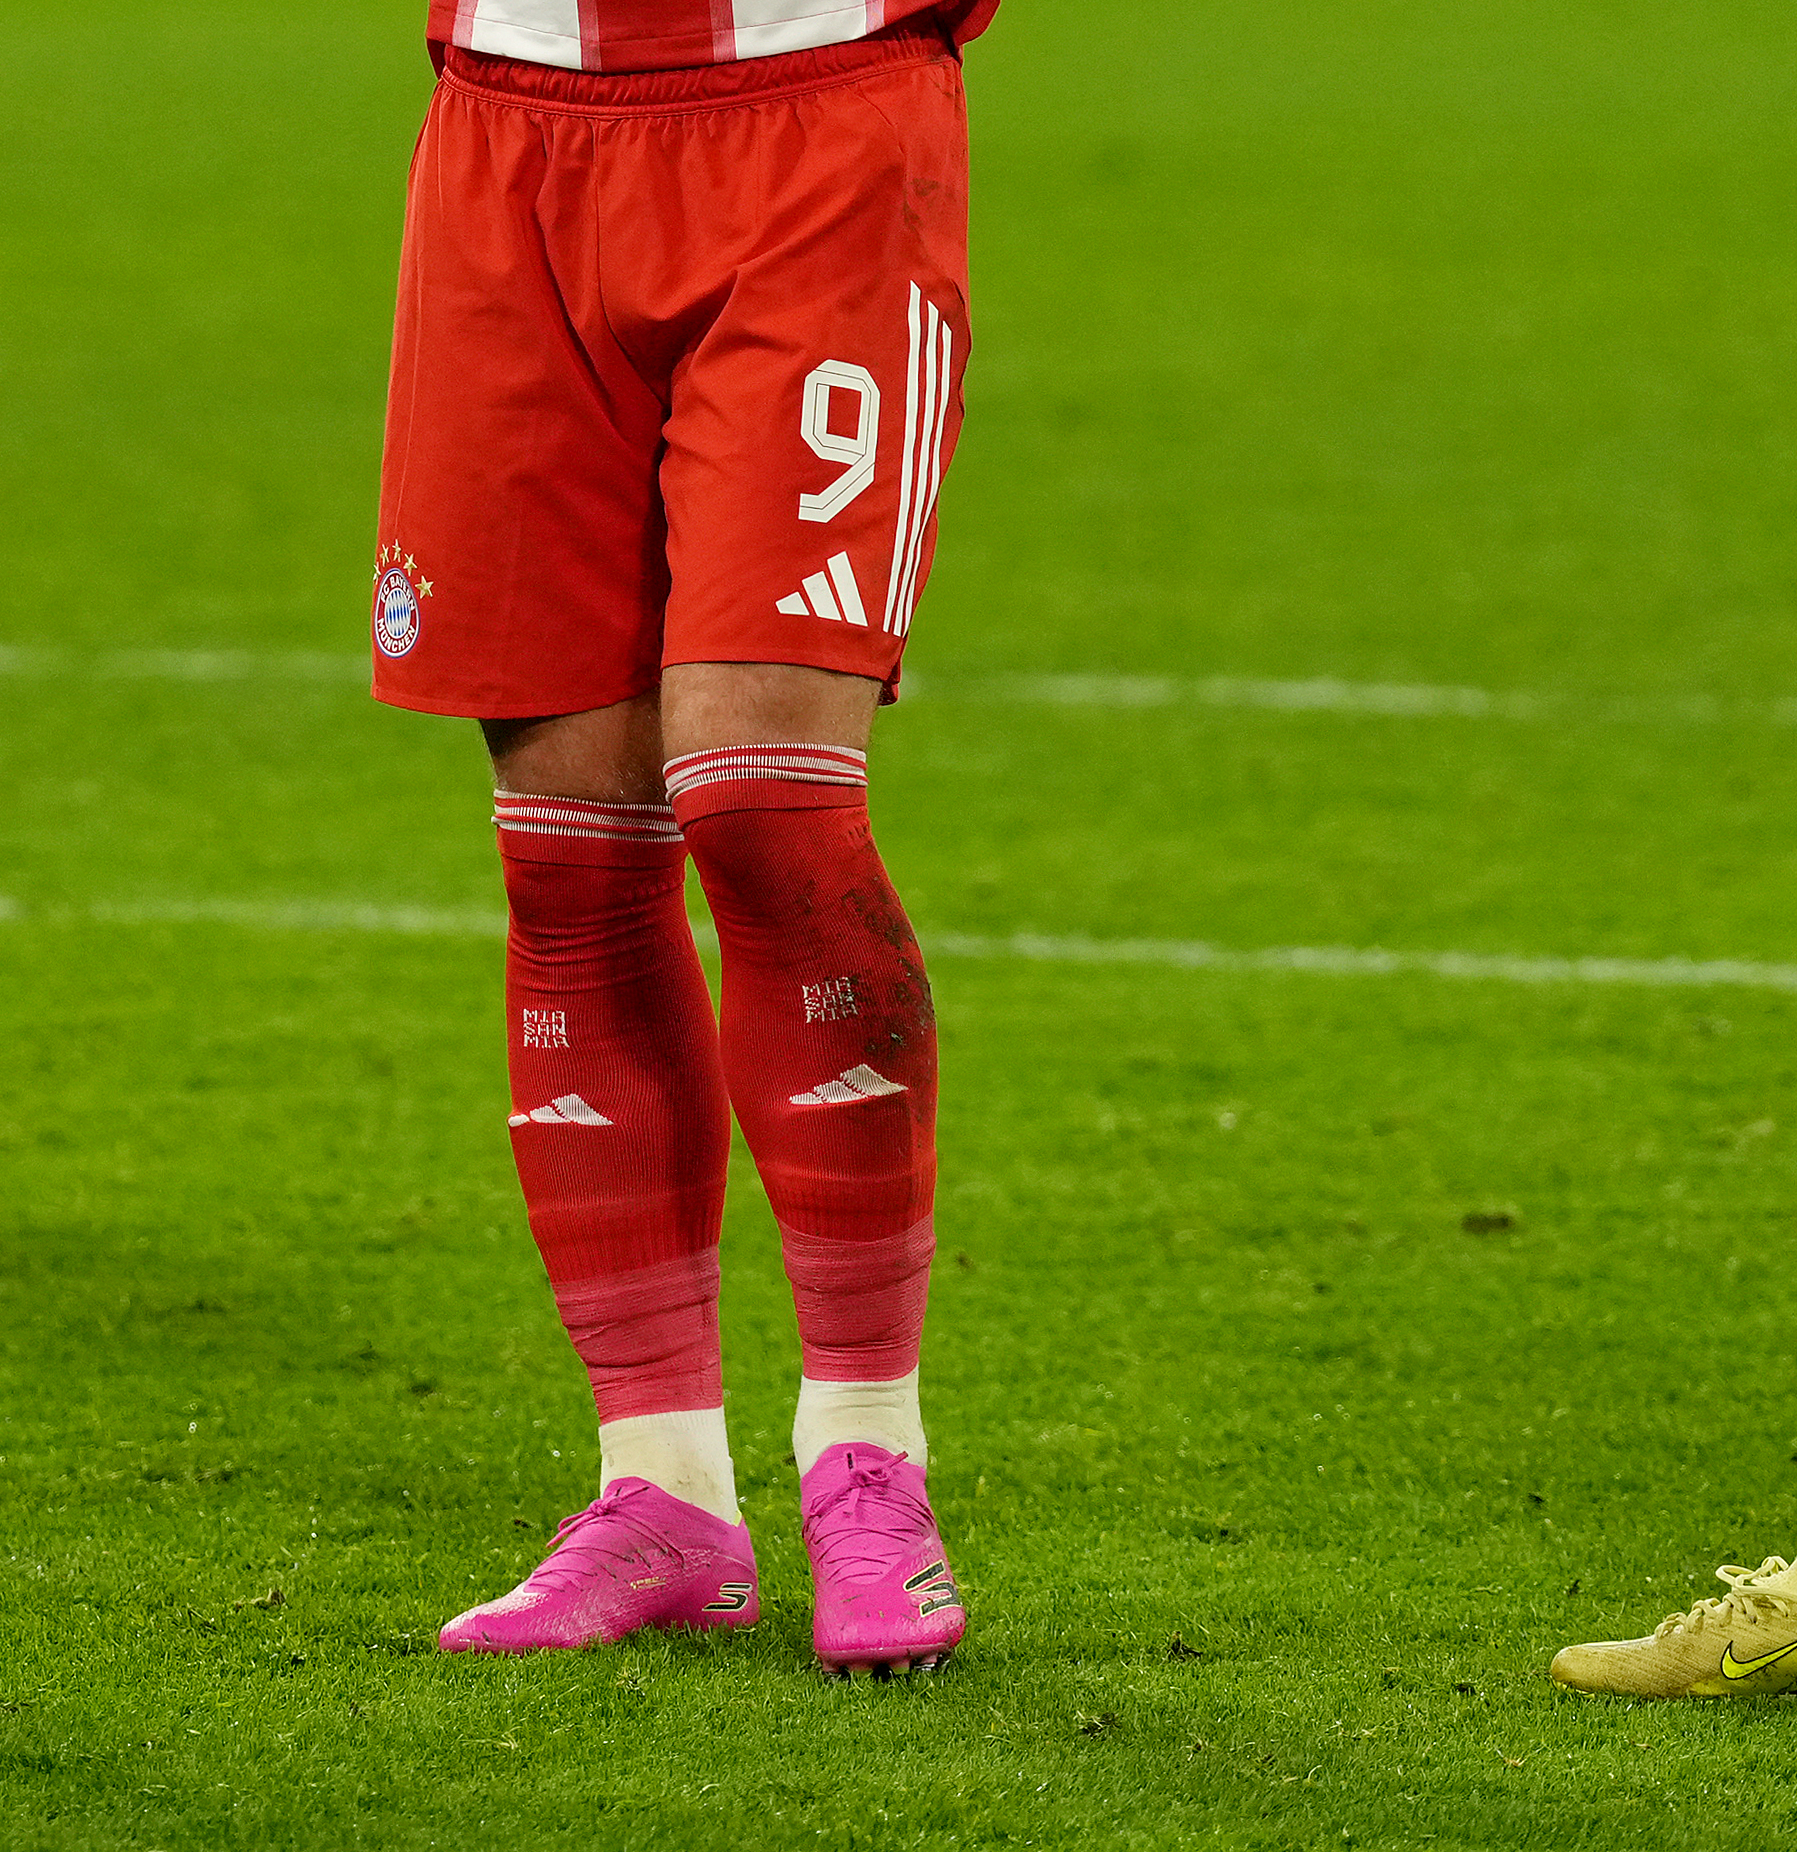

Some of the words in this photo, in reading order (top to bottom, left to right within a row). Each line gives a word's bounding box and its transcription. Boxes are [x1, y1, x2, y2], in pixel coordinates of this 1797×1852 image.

[798, 358, 881, 523] 9
[523, 1009, 565, 1023] MIA
[523, 1023, 566, 1035] SAN
[524, 1034, 570, 1048] MIA
